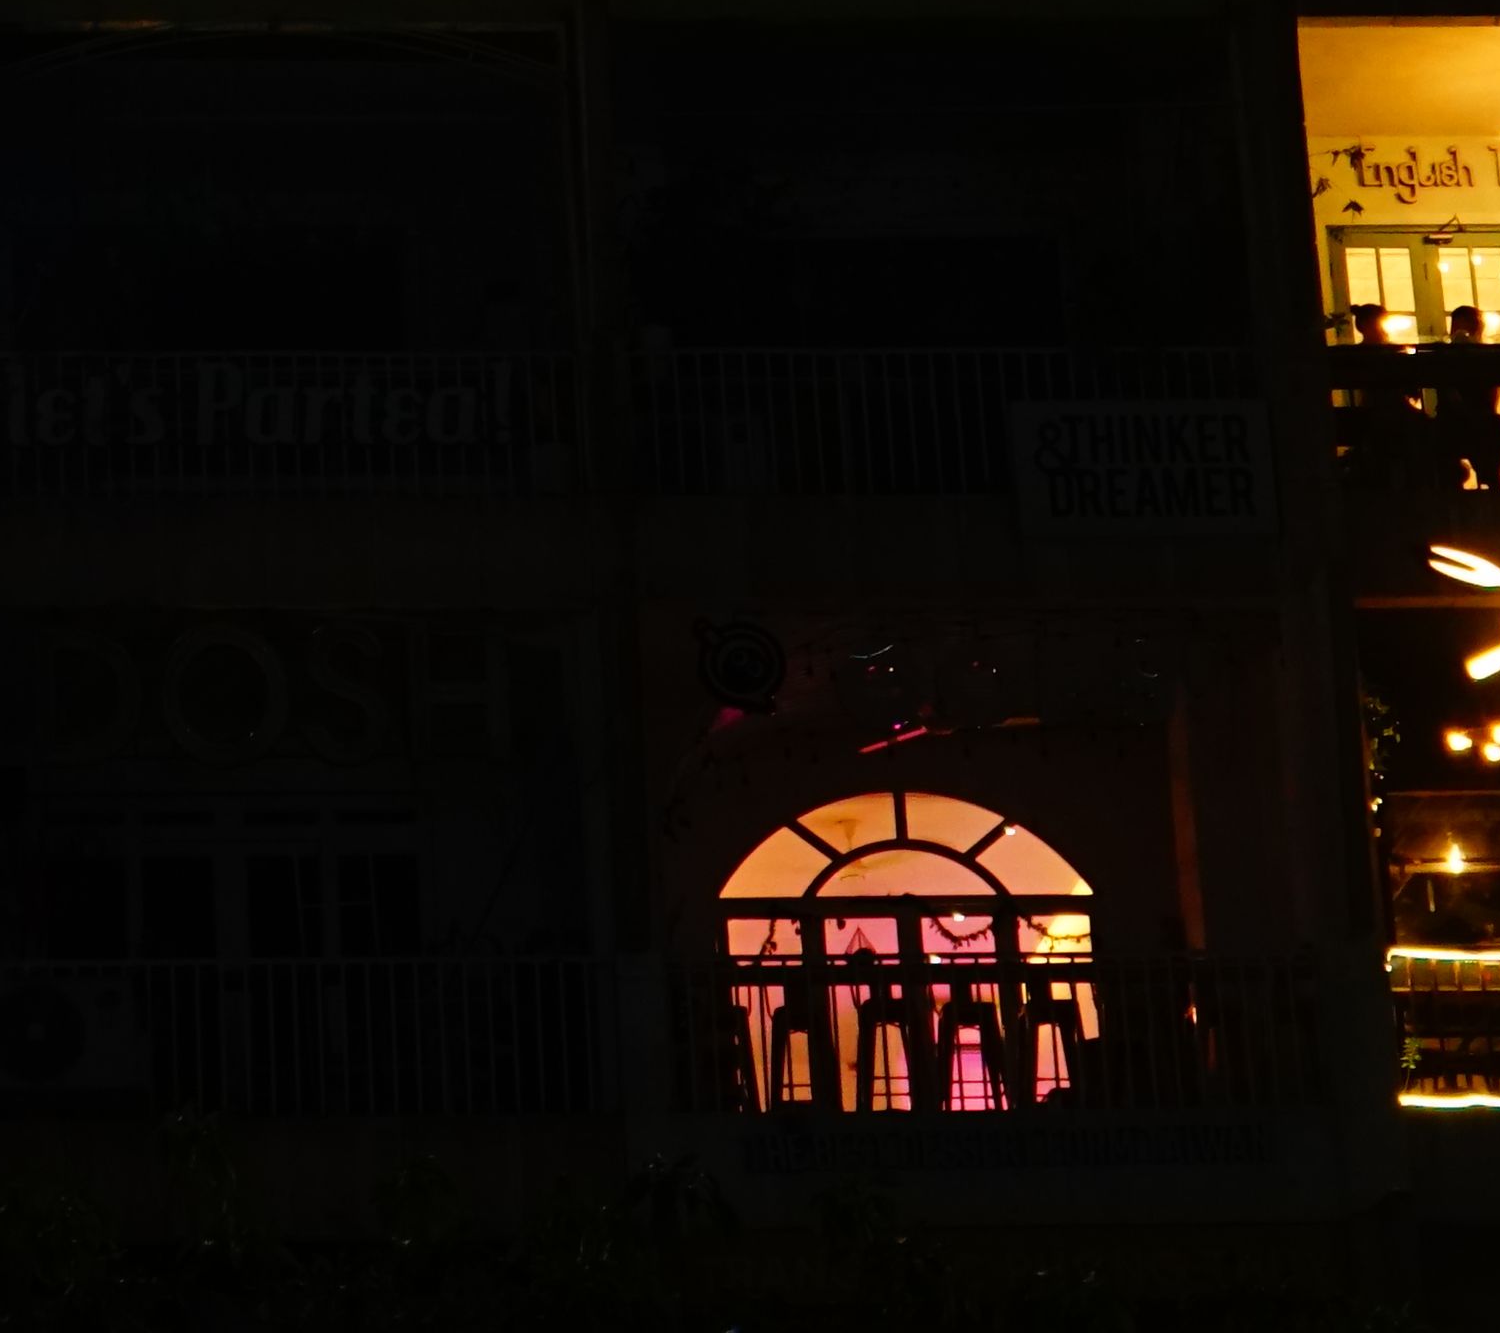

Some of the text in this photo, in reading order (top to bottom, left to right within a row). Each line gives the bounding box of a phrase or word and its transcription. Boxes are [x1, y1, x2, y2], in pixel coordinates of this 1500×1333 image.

[1357, 143, 1475, 205] English
[195, 360, 514, 447] Partea!
[1048, 466, 1258, 518] DREAMER
